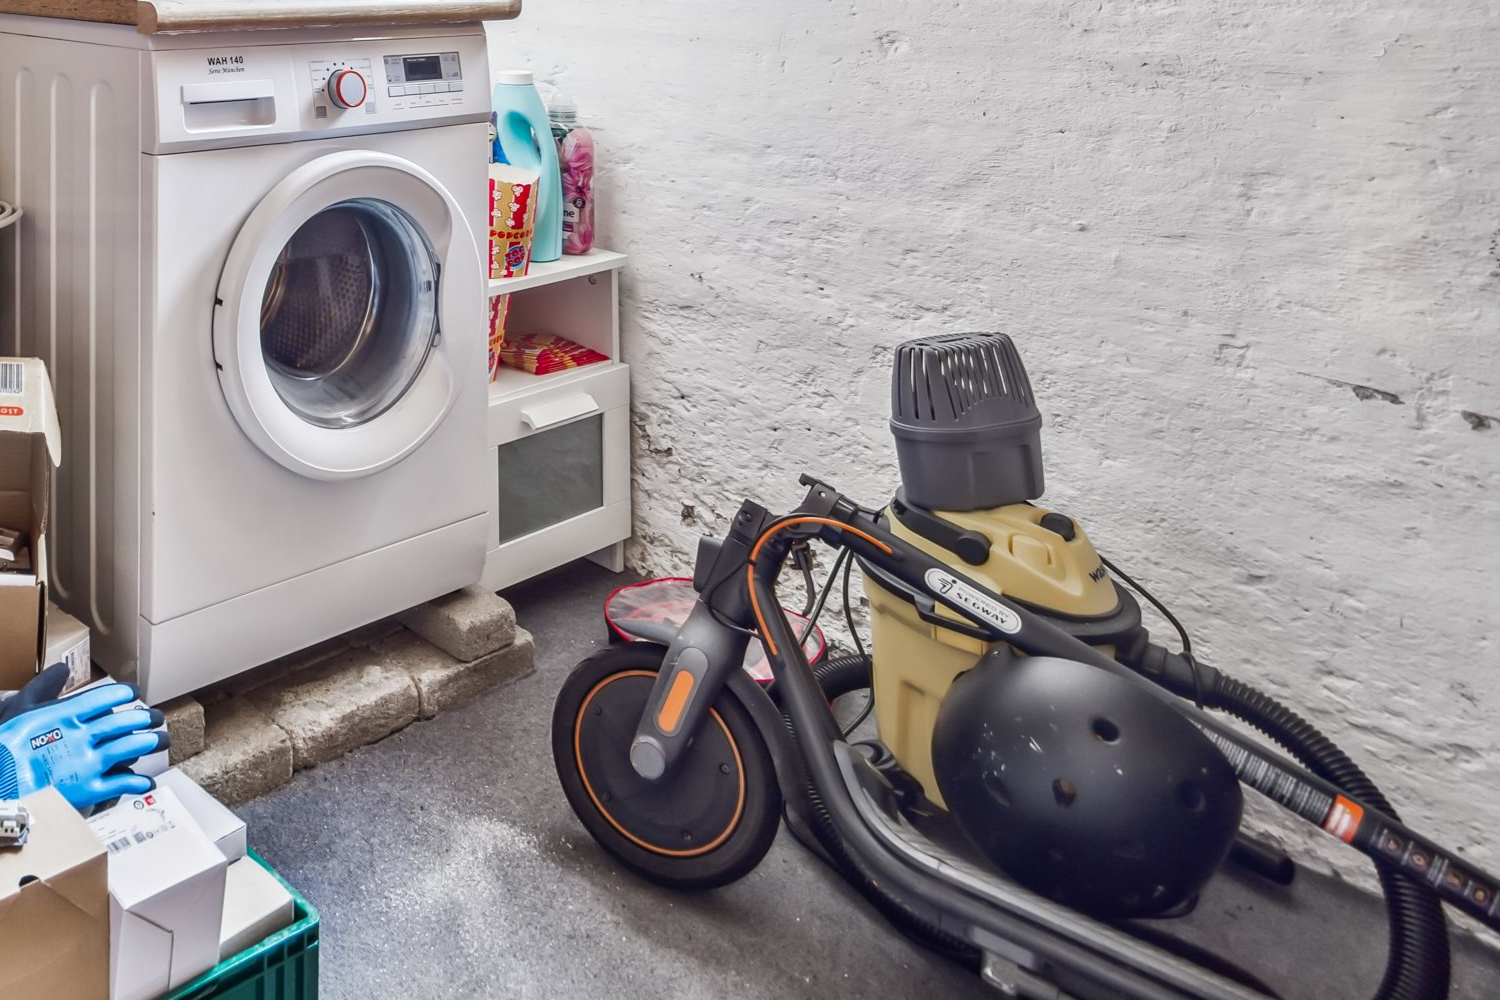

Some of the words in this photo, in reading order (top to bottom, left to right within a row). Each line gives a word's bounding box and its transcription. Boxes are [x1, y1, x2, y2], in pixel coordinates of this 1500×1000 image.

[207, 56, 228, 66] WAH
[229, 55, 244, 65] 140
[956, 592, 1008, 624] SEGWAY
